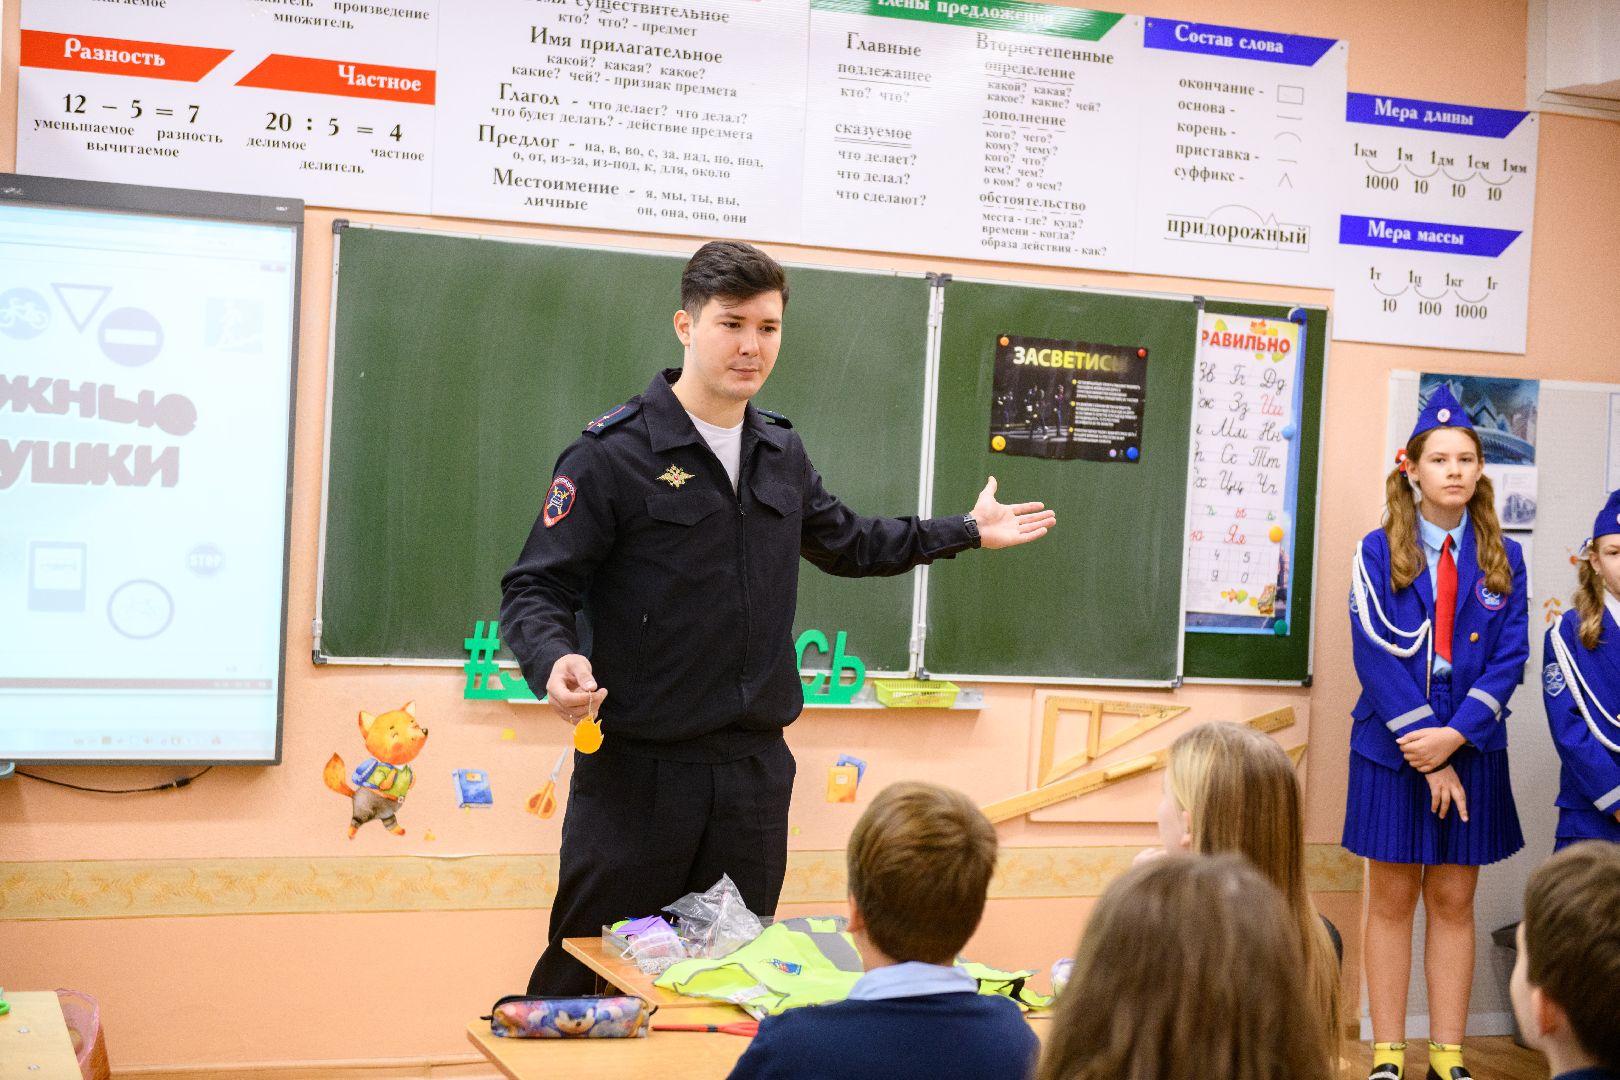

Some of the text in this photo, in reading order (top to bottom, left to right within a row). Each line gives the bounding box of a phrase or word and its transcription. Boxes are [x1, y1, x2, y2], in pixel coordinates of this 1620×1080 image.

[275, 13, 353, 29] множитель
[334, 2, 429, 19] произведение
[559, 13, 696, 36] кто? что? предмет
[531, 26, 723, 63] Имя прилагательное
[847, 32, 921, 56] Главные
[976, 32, 1114, 64] Второстепенные
[1175, 24, 1283, 53] Состав слова
[63, 38, 166, 67] Разность
[338, 64, 422, 91] Частное
[547, 55, 705, 79] какой? какая? какое?
[985, 61, 1075, 80] определение
[512, 66, 736, 97] какие? чей? признак предмета
[1034, 87, 1072, 97] какая?
[1179, 79, 1254, 96] окончание
[65, 94, 199, 123] 12 5 7
[500, 83, 559, 105] Глагол
[589, 101, 611, 110] что
[616, 104, 667, 116] делает?
[677, 110, 698, 119] что
[1178, 101, 1225, 114] основа
[1375, 98, 1473, 125] Мера длины
[266, 112, 402, 141] 20 5 4
[492, 107, 752, 140] что будет делать? действие предмета
[982, 110, 1066, 126] дополнение
[34, 120, 222, 143] уменьшаемое разность
[835, 123, 912, 140] сказуемое
[1178, 123, 1226, 137] корень
[87, 142, 179, 157] вычитаемое
[247, 138, 424, 160] делимое частное
[479, 125, 559, 148] Предлог
[586, 144, 604, 152] на,
[609, 145, 620, 155] в,
[625, 147, 643, 156] во,
[648, 149, 658, 159] с,
[663, 151, 679, 159] за,
[1177, 145, 1249, 160] приставка
[1355, 143, 1377, 158] 1км
[1398, 147, 1413, 161] 1м
[299, 160, 365, 174] делитель
[513, 152, 524, 161] о,
[529, 153, 546, 163] от,
[552, 155, 588, 166] из-за,
[593, 159, 639, 171] из-под,
[645, 164, 656, 174] к,
[692, 168, 730, 178] около
[838, 150, 917, 165] что делает?
[837, 170, 910, 184] что делал?
[1175, 165, 1234, 182] суффикс
[493, 168, 619, 195] Местоимение
[646, 190, 657, 198] я,
[662, 192, 686, 202] мы,
[718, 197, 739, 206] вы,
[837, 190, 859, 200] что
[1366, 175, 1502, 201] 1000 10 10 10
[524, 197, 587, 210] личные
[979, 192, 1086, 211] обстоятельство
[638, 207, 746, 223] он, она, оно, они
[1167, 218, 1307, 245] придорожный
[1368, 220, 1464, 245] Мера массы
[1384, 298, 1487, 319] 10 100 1000
[1202, 330, 1290, 353] РАВИЛЬНО
